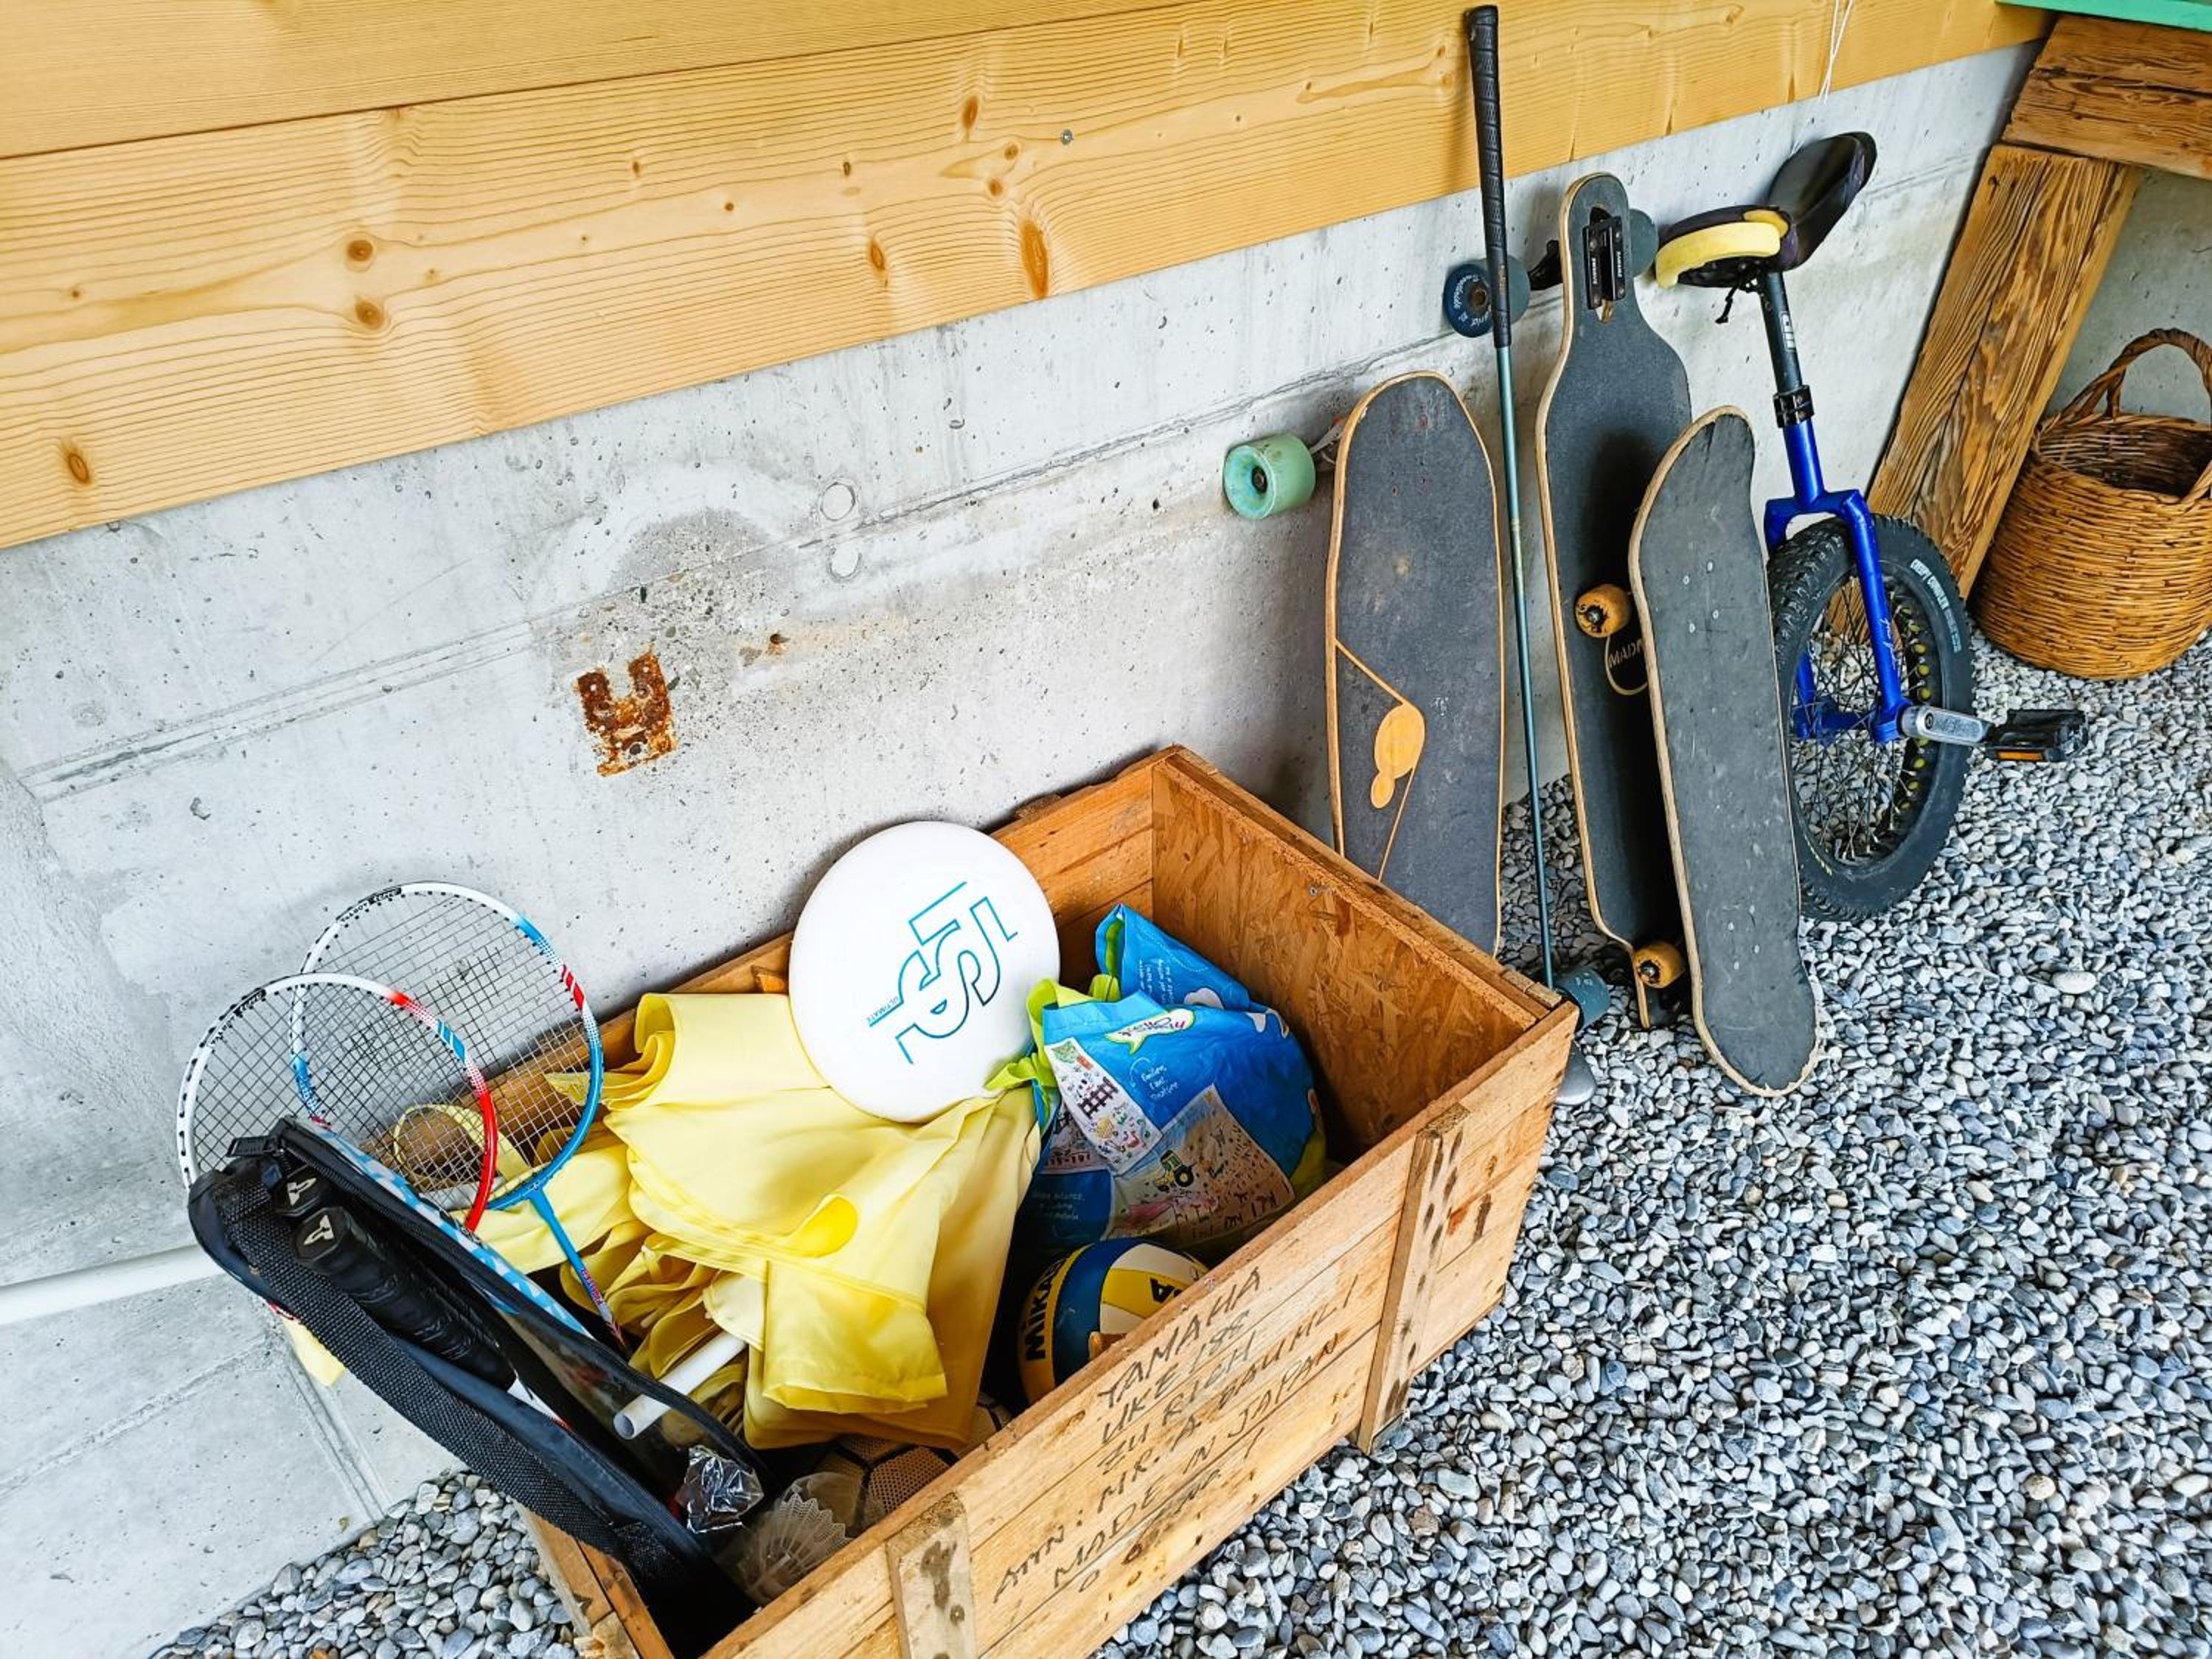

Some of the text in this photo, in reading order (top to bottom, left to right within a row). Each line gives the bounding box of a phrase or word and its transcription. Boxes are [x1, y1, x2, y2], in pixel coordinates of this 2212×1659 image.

[1098, 1266, 1260, 1408] YAMAHA
[1054, 1333, 1338, 1587] MADE IN JAPAN
